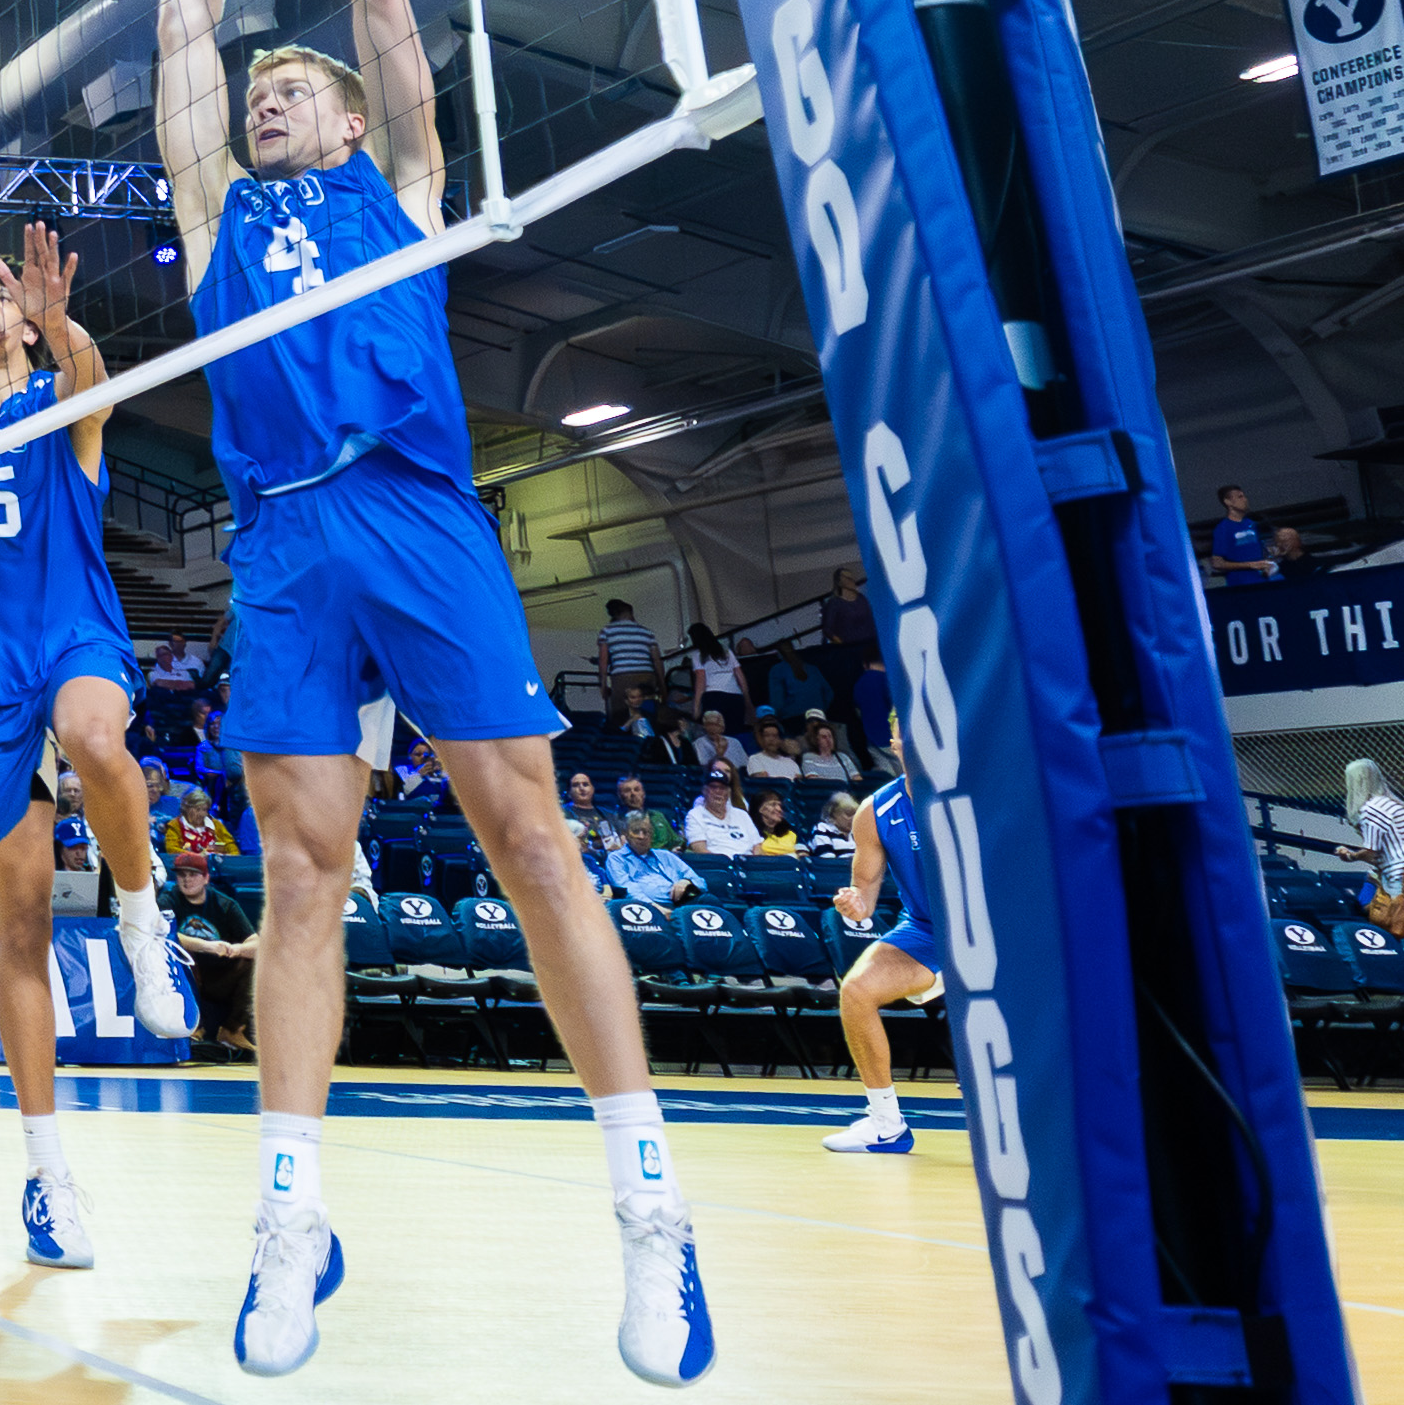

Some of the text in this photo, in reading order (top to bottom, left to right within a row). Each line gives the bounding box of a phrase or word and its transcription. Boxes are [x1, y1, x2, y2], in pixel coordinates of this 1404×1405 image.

[1312, 44, 1402, 86] CONFERENCE
[1317, 65, 1404, 104] CHAMPIONS
[263, 216, 326, 295] 4
[1211, 616, 1283, 665] OR
[71, 823, 82, 837] Y
[864, 421, 1063, 1405] COUGS
